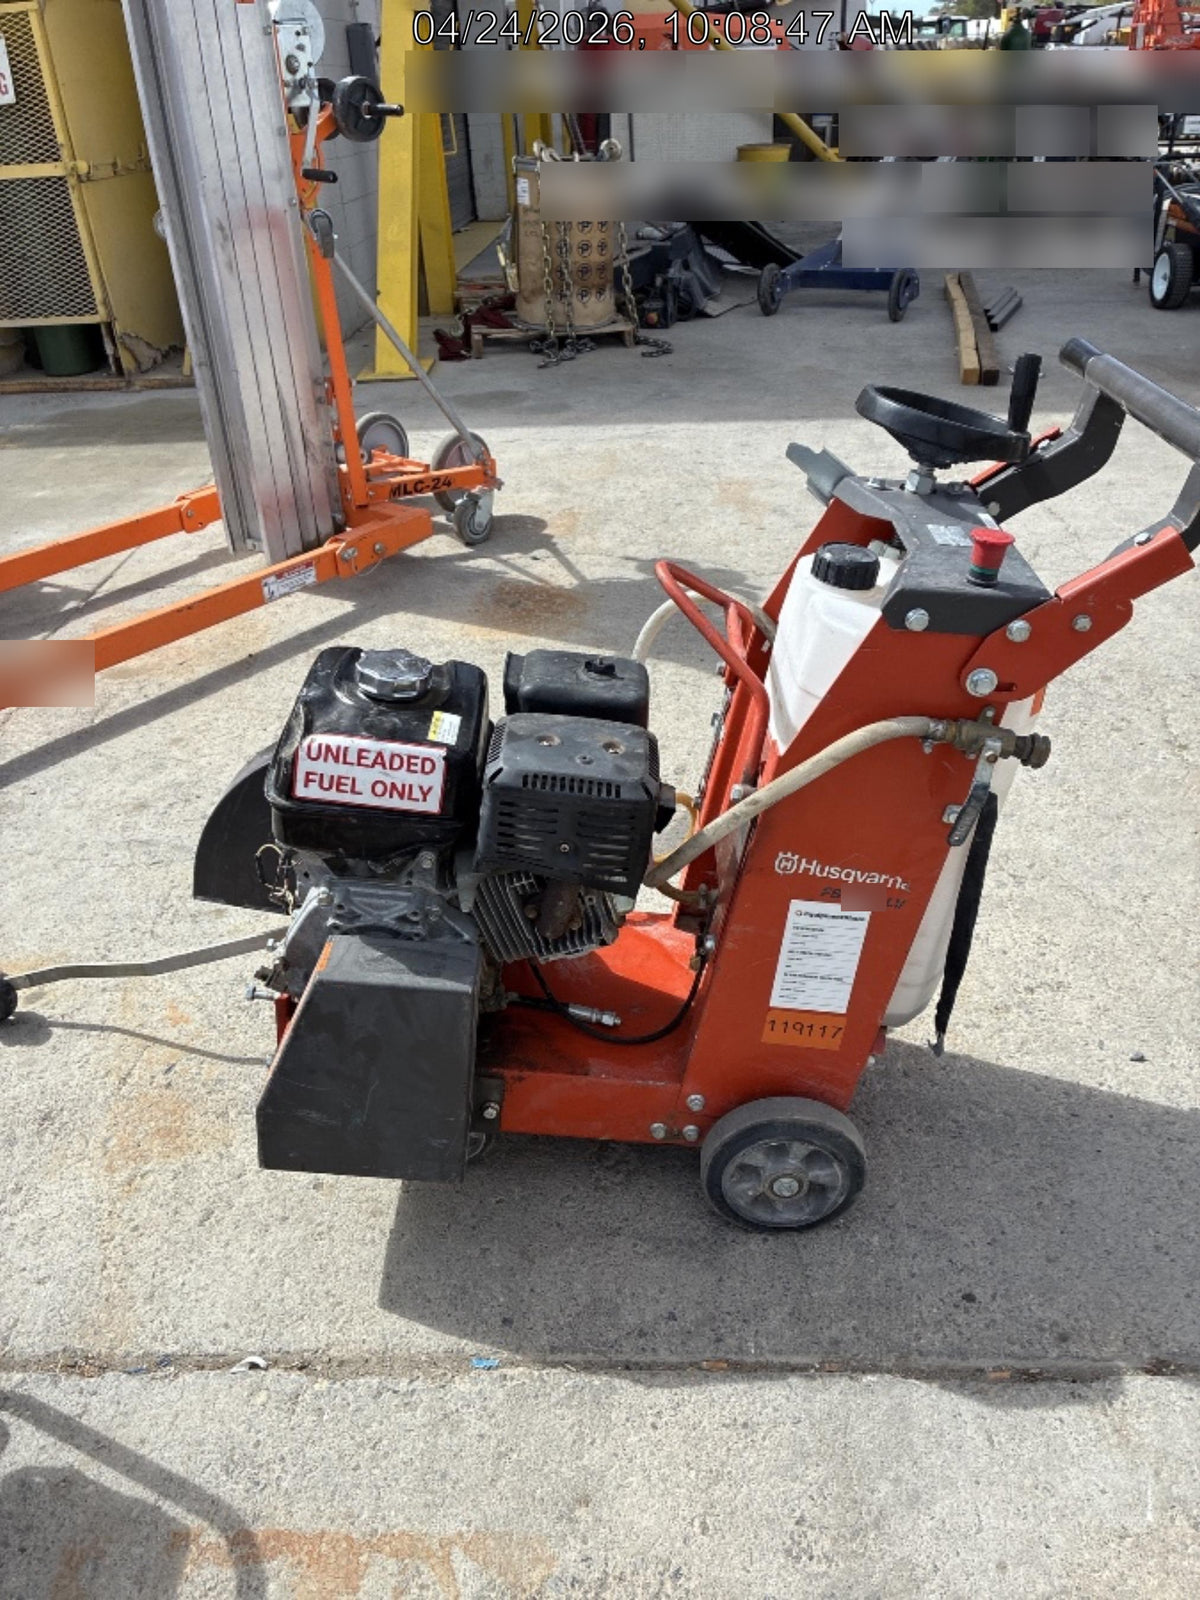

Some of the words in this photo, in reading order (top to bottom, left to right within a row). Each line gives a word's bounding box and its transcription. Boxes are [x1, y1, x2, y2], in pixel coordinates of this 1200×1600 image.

[390, 475, 453, 498] MLC-24
[305, 740, 437, 776] UNLEADED
[303, 770, 363, 796] FUEL
[370, 779, 434, 803] ONLY
[767, 1019, 843, 1040] 119117
